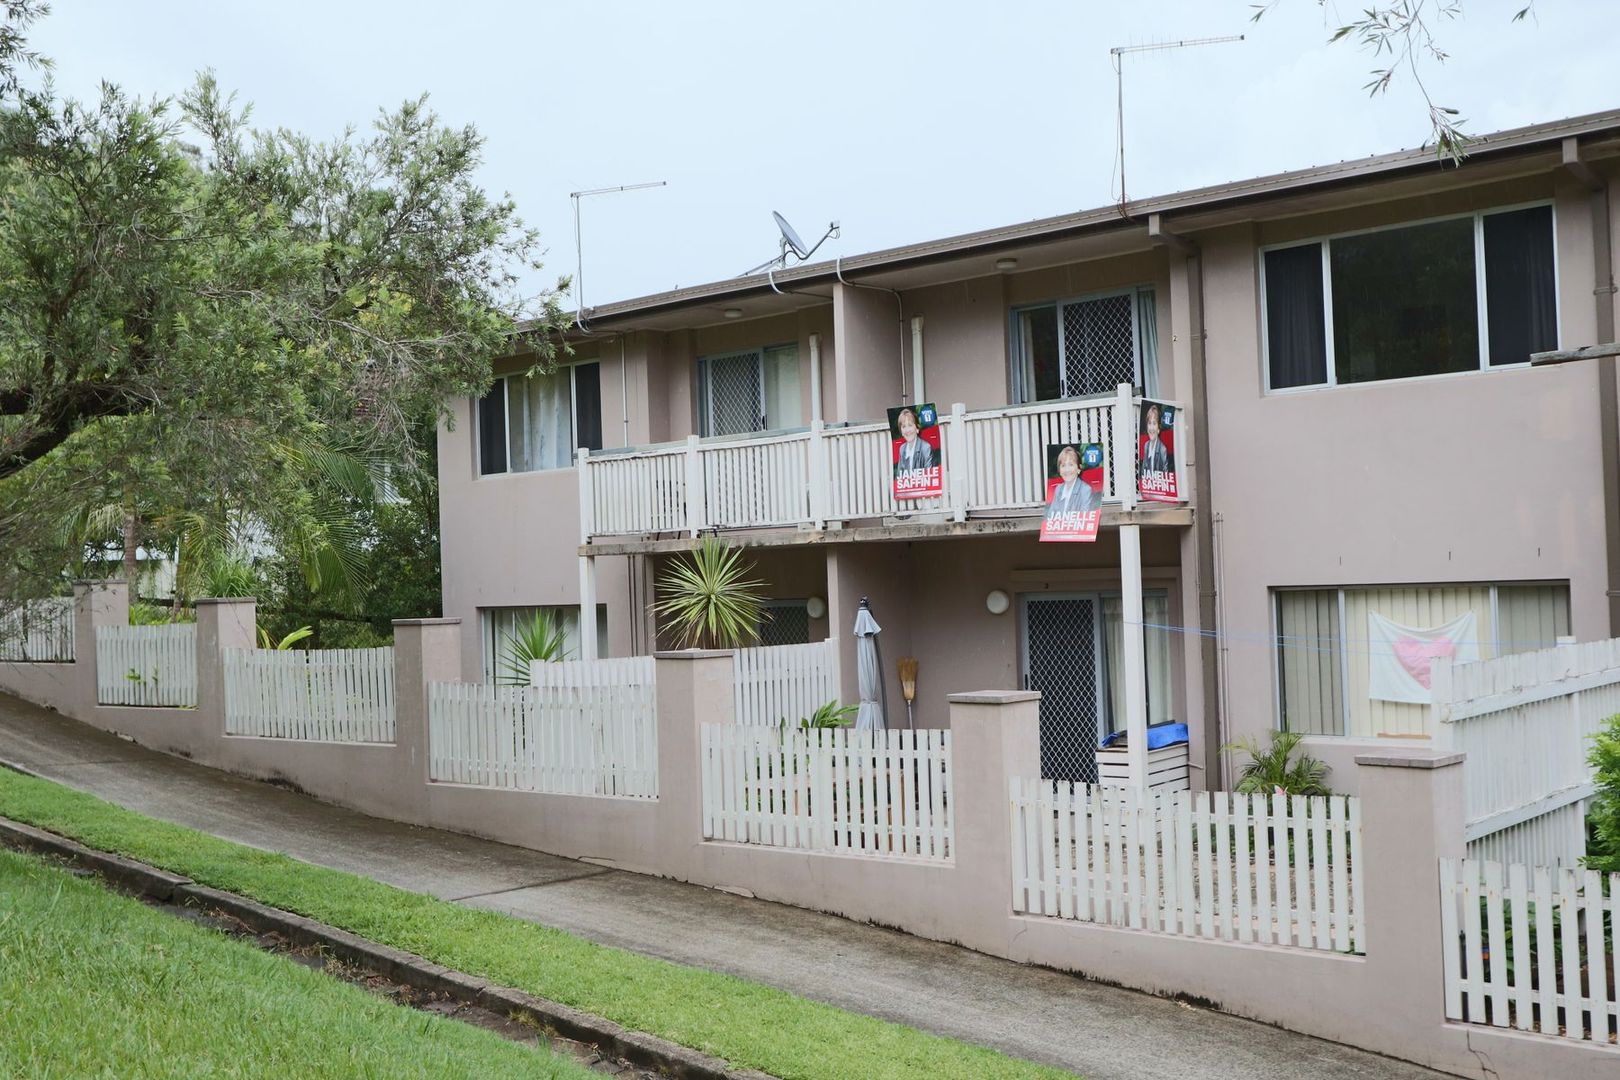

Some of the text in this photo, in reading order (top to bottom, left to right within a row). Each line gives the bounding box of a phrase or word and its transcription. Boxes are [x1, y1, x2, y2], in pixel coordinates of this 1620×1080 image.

[896, 466, 939, 480] JANELLE
[1141, 469, 1175, 483] JANELLE
[896, 477, 931, 489] SAFFIN
[1141, 479, 1169, 492] SAFFIN
[1047, 510, 1097, 521] JANELLE
[1045, 520, 1085, 531] SAFFIN
